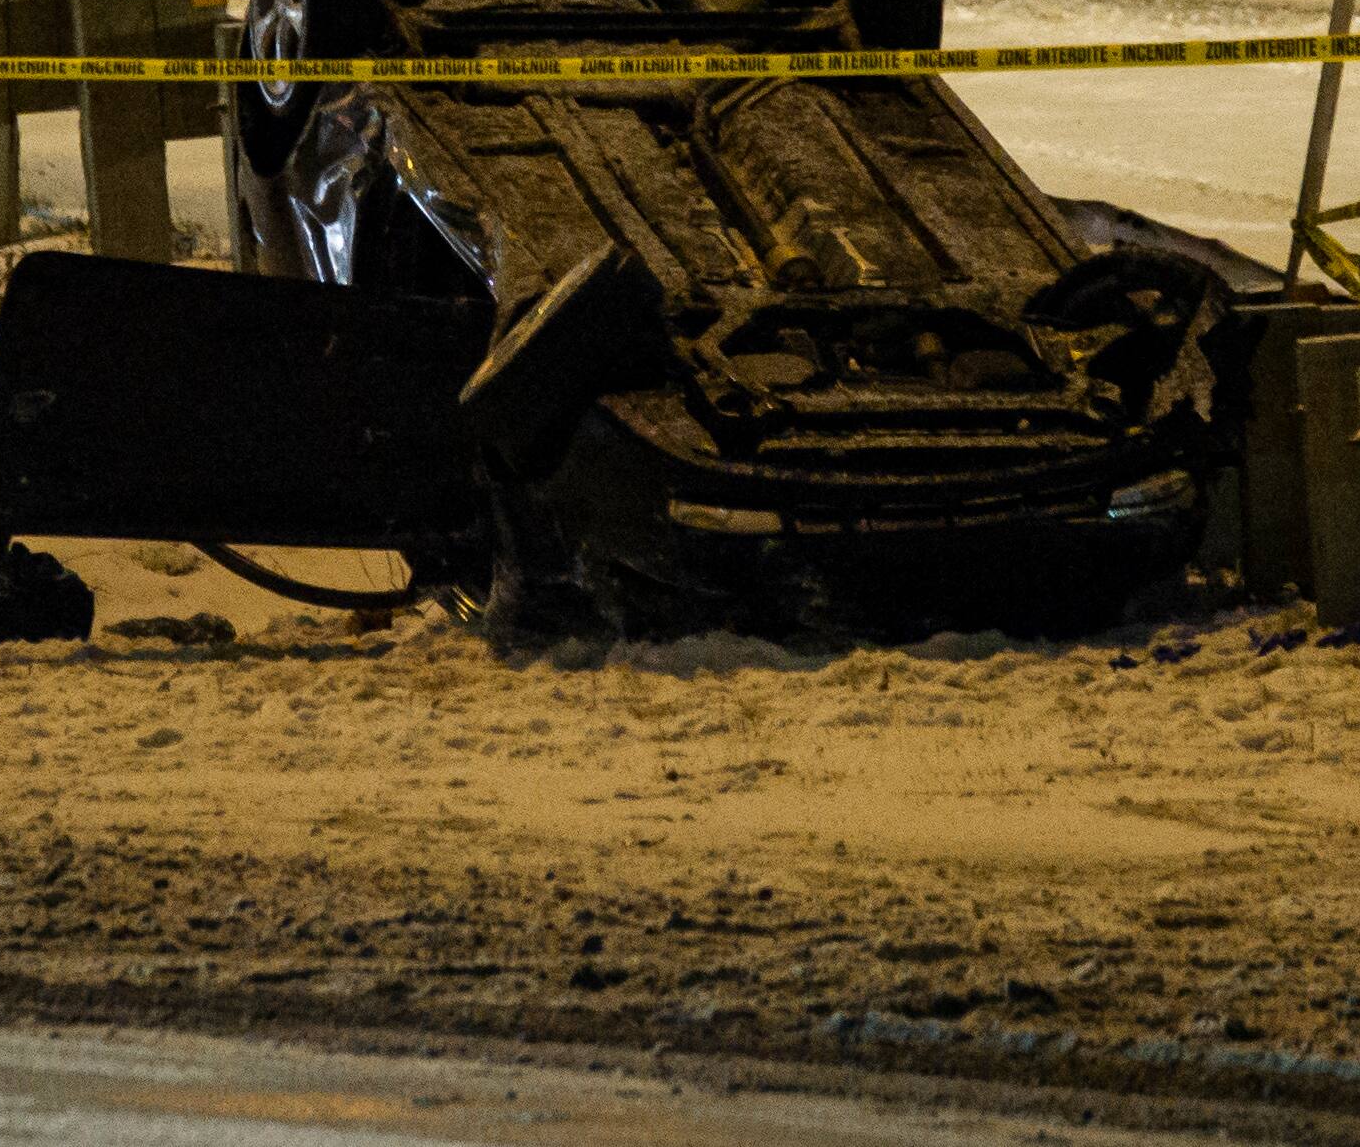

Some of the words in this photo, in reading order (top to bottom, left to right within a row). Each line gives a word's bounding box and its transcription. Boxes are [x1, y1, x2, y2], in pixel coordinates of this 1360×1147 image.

[828, 52, 900, 69] INTERDITE
[913, 51, 978, 68] INCENDIE
[997, 49, 1032, 66] ZONE
[1036, 46, 1108, 65] INTERDITE
[1121, 43, 1187, 62] INCENDIE
[1205, 41, 1241, 59] ZONE
[1245, 38, 1318, 59] INTERDITE
